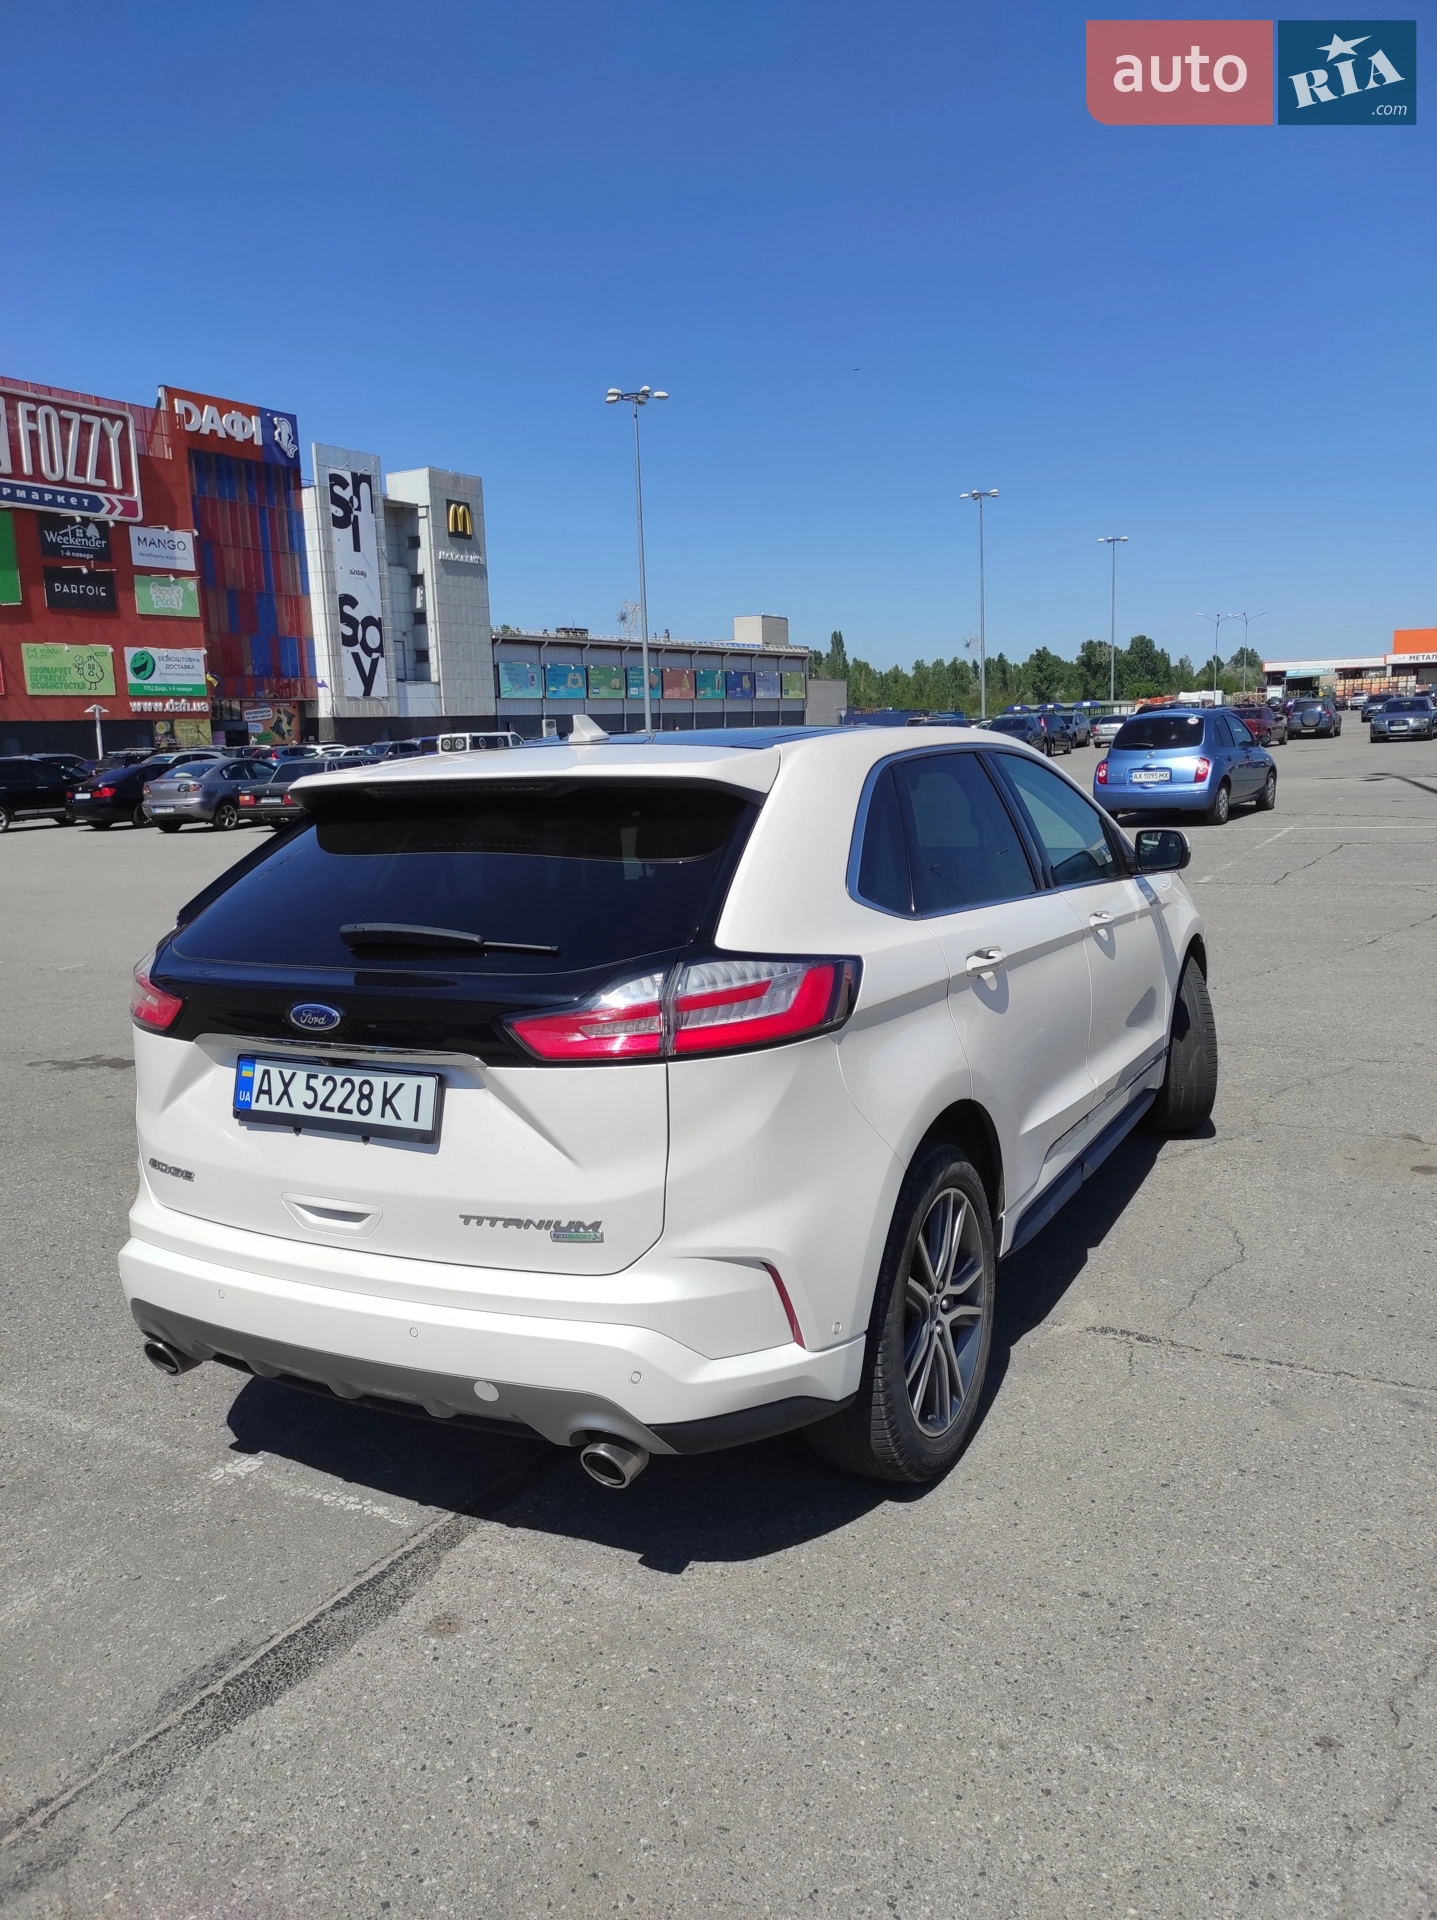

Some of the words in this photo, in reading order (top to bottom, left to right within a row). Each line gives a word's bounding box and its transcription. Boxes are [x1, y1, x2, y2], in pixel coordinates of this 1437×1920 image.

[18, 401, 123, 490] FOZZY
[43, 525, 107, 548] Weekender
[137, 535, 187, 551] MANGO
[71, 551, 94, 560] поверх
[54, 582, 107, 597] PARFOIS
[28, 666, 72, 675] ЗООМАРКЕТ
[130, 698, 209, 712] www.dafi.ua
[299, 1009, 327, 1025] Ford
[239, 1090, 251, 1102] UA
[254, 1068, 297, 1108] AX
[302, 1072, 375, 1117] 5228
[148, 1157, 196, 1183] EDGE
[458, 1214, 603, 1233] TITANIUM
